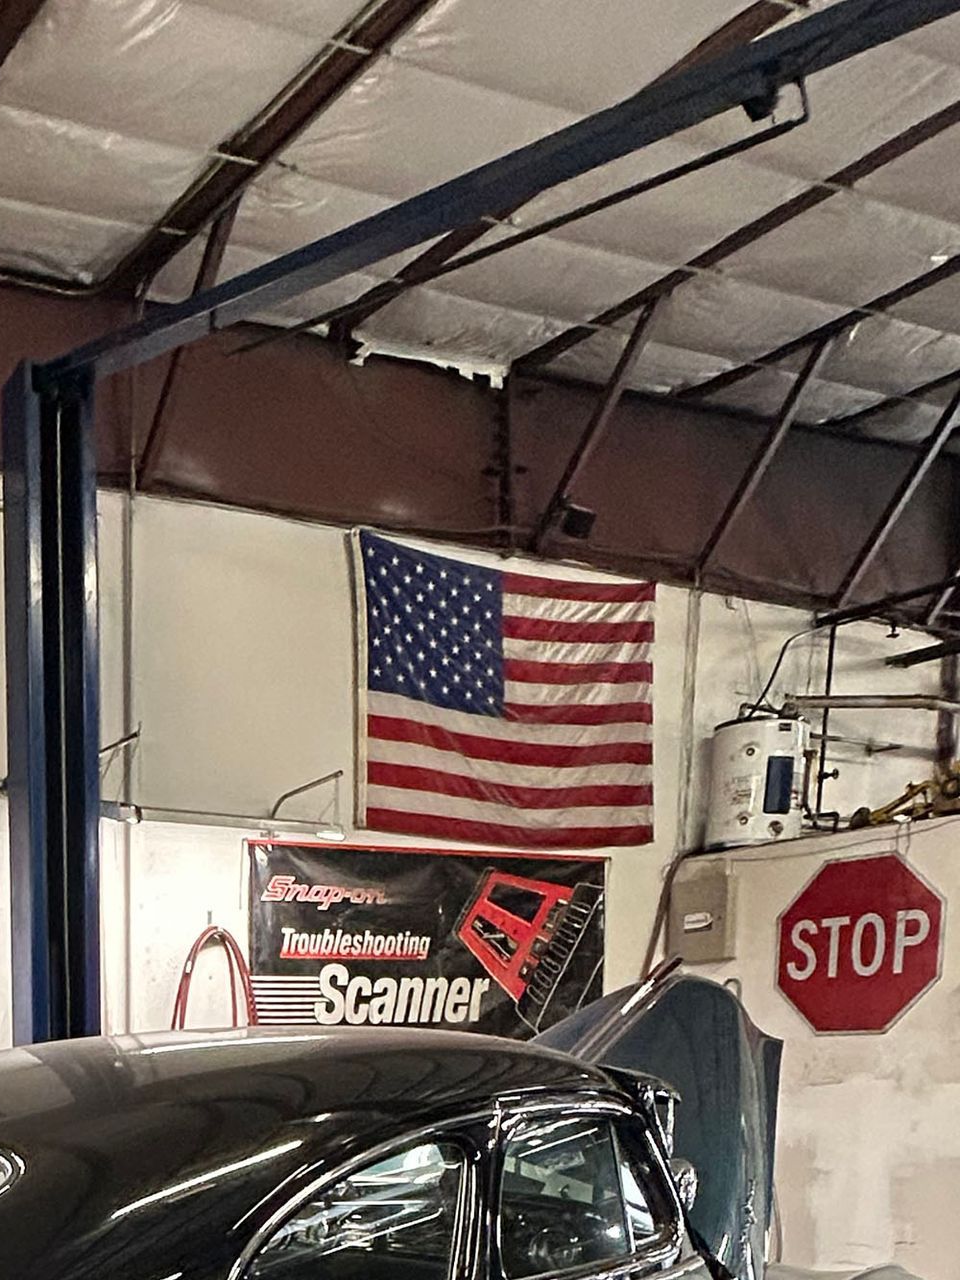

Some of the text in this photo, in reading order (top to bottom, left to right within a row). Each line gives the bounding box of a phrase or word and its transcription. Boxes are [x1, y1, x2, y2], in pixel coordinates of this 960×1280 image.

[260, 875, 388, 911] Snap-on
[280, 927, 431, 960] Troubleshooting
[786, 909, 931, 981] STOP
[314, 963, 490, 1025] Scanner
